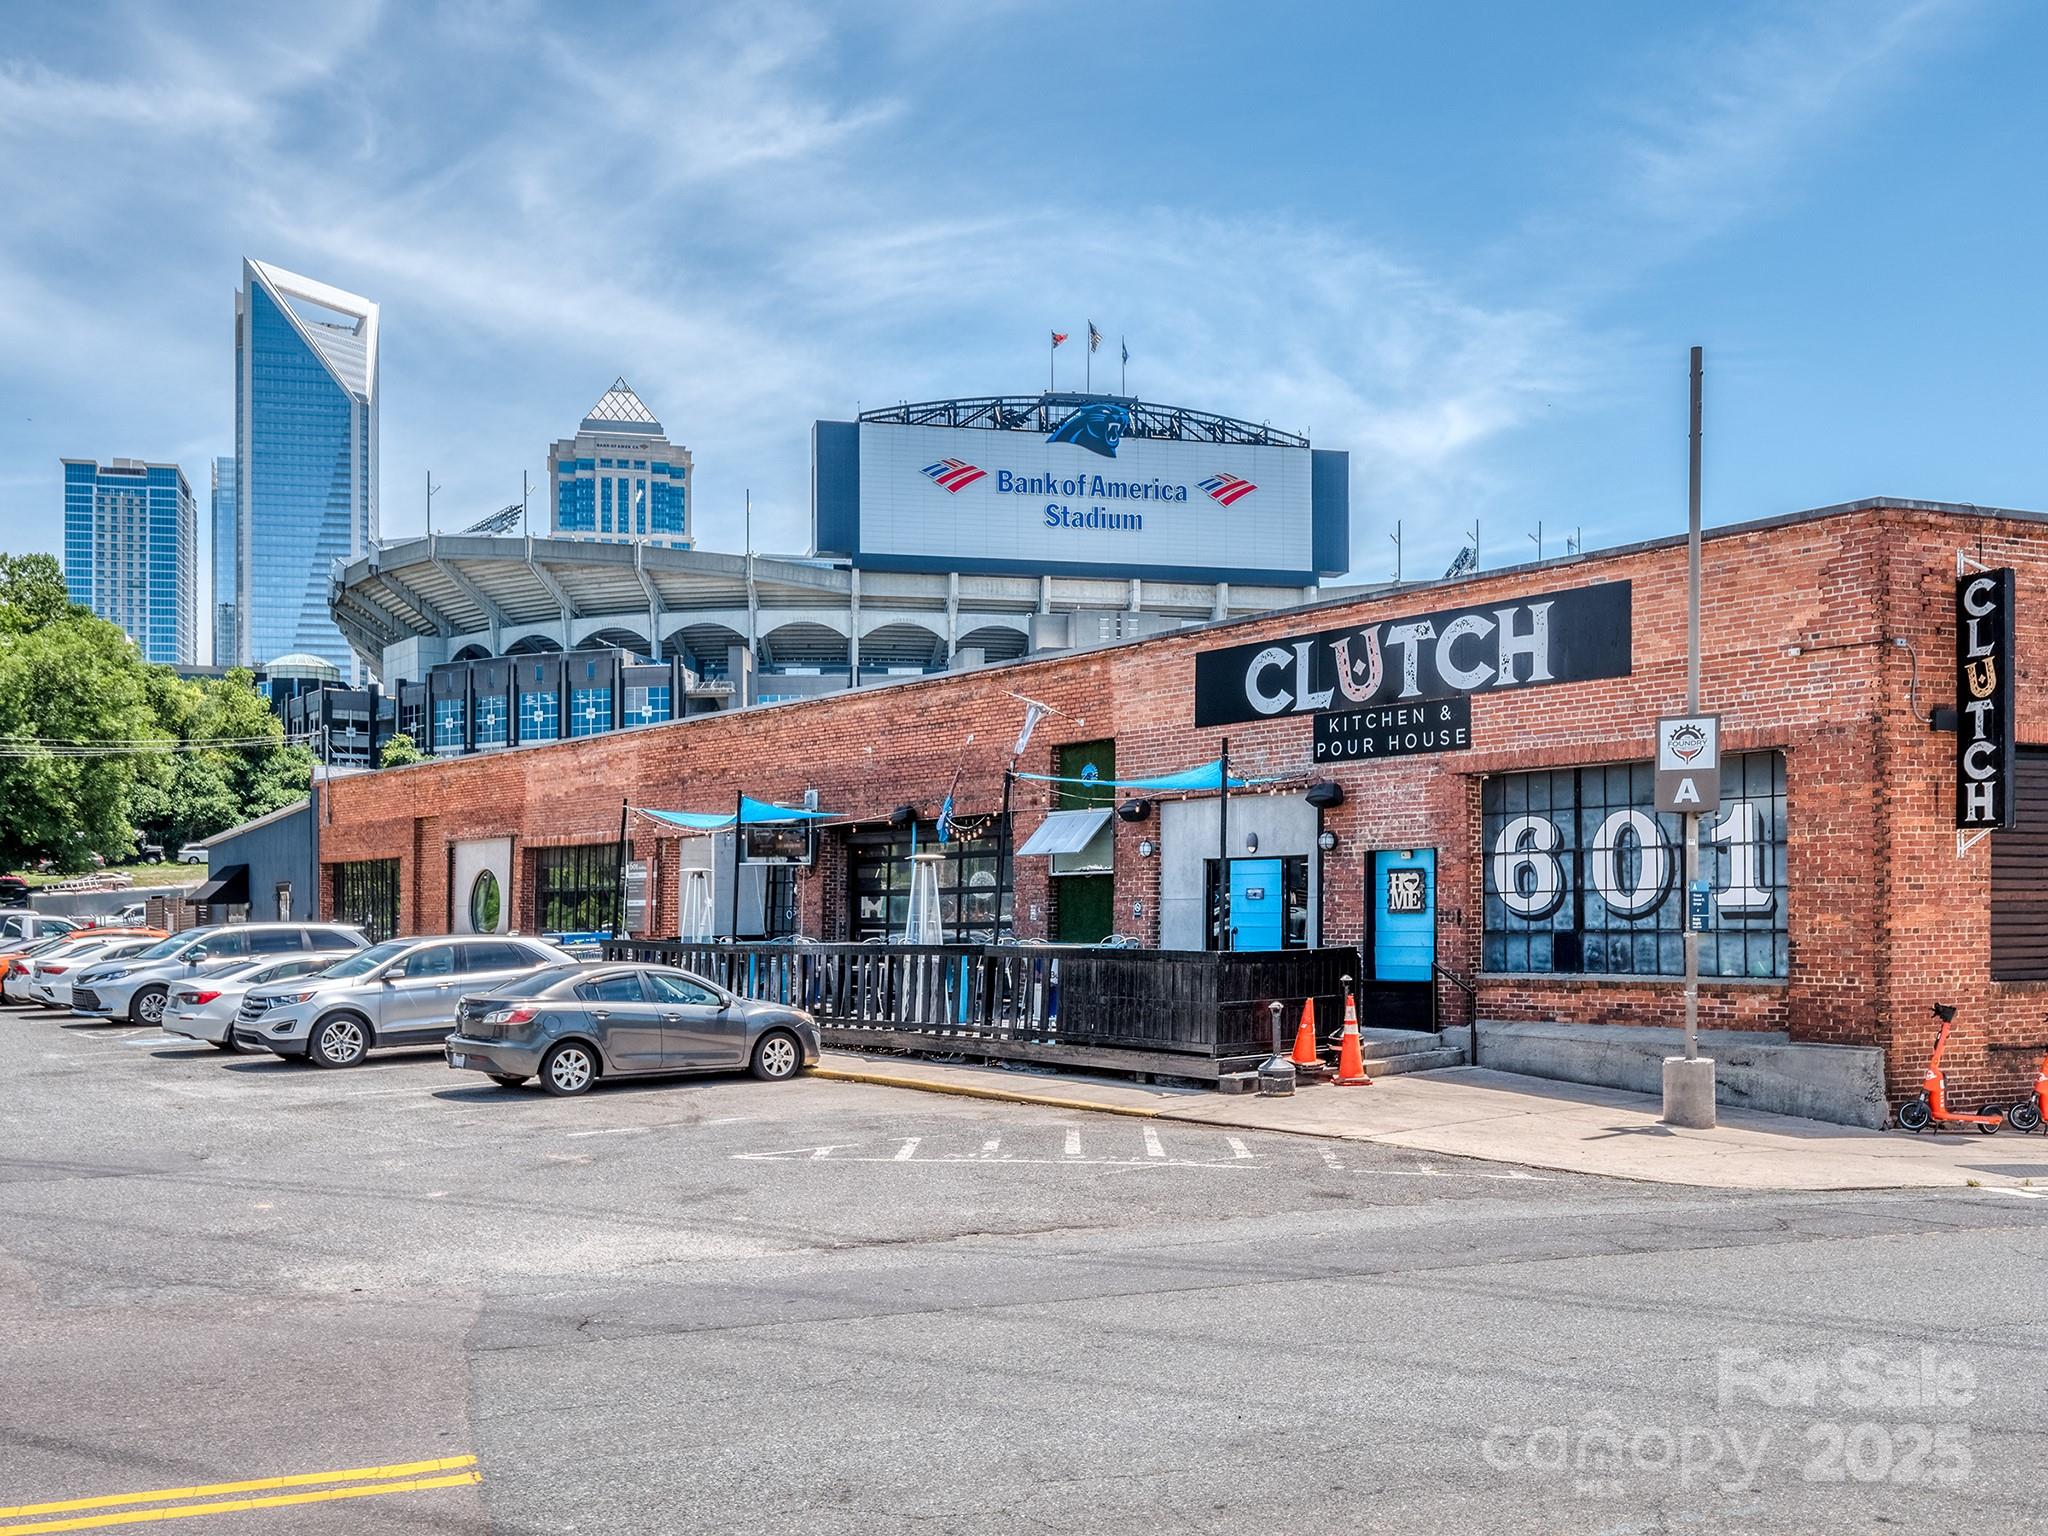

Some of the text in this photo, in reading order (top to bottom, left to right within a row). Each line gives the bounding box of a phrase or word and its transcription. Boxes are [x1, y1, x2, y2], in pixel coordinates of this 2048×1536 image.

[996, 469, 1187, 502] Bank of America
[1044, 503, 1143, 530] Stadium
[1244, 600, 1555, 715] CLUTCH
[1962, 577, 1997, 822] CLUTCH
[1329, 704, 1452, 734] KITCHEN &
[1316, 727, 1467, 757] POUR HOUSE
[1667, 739, 1708, 748] FOUNDRY
[1673, 777, 1700, 804] A
[1492, 803, 1777, 922] 601
